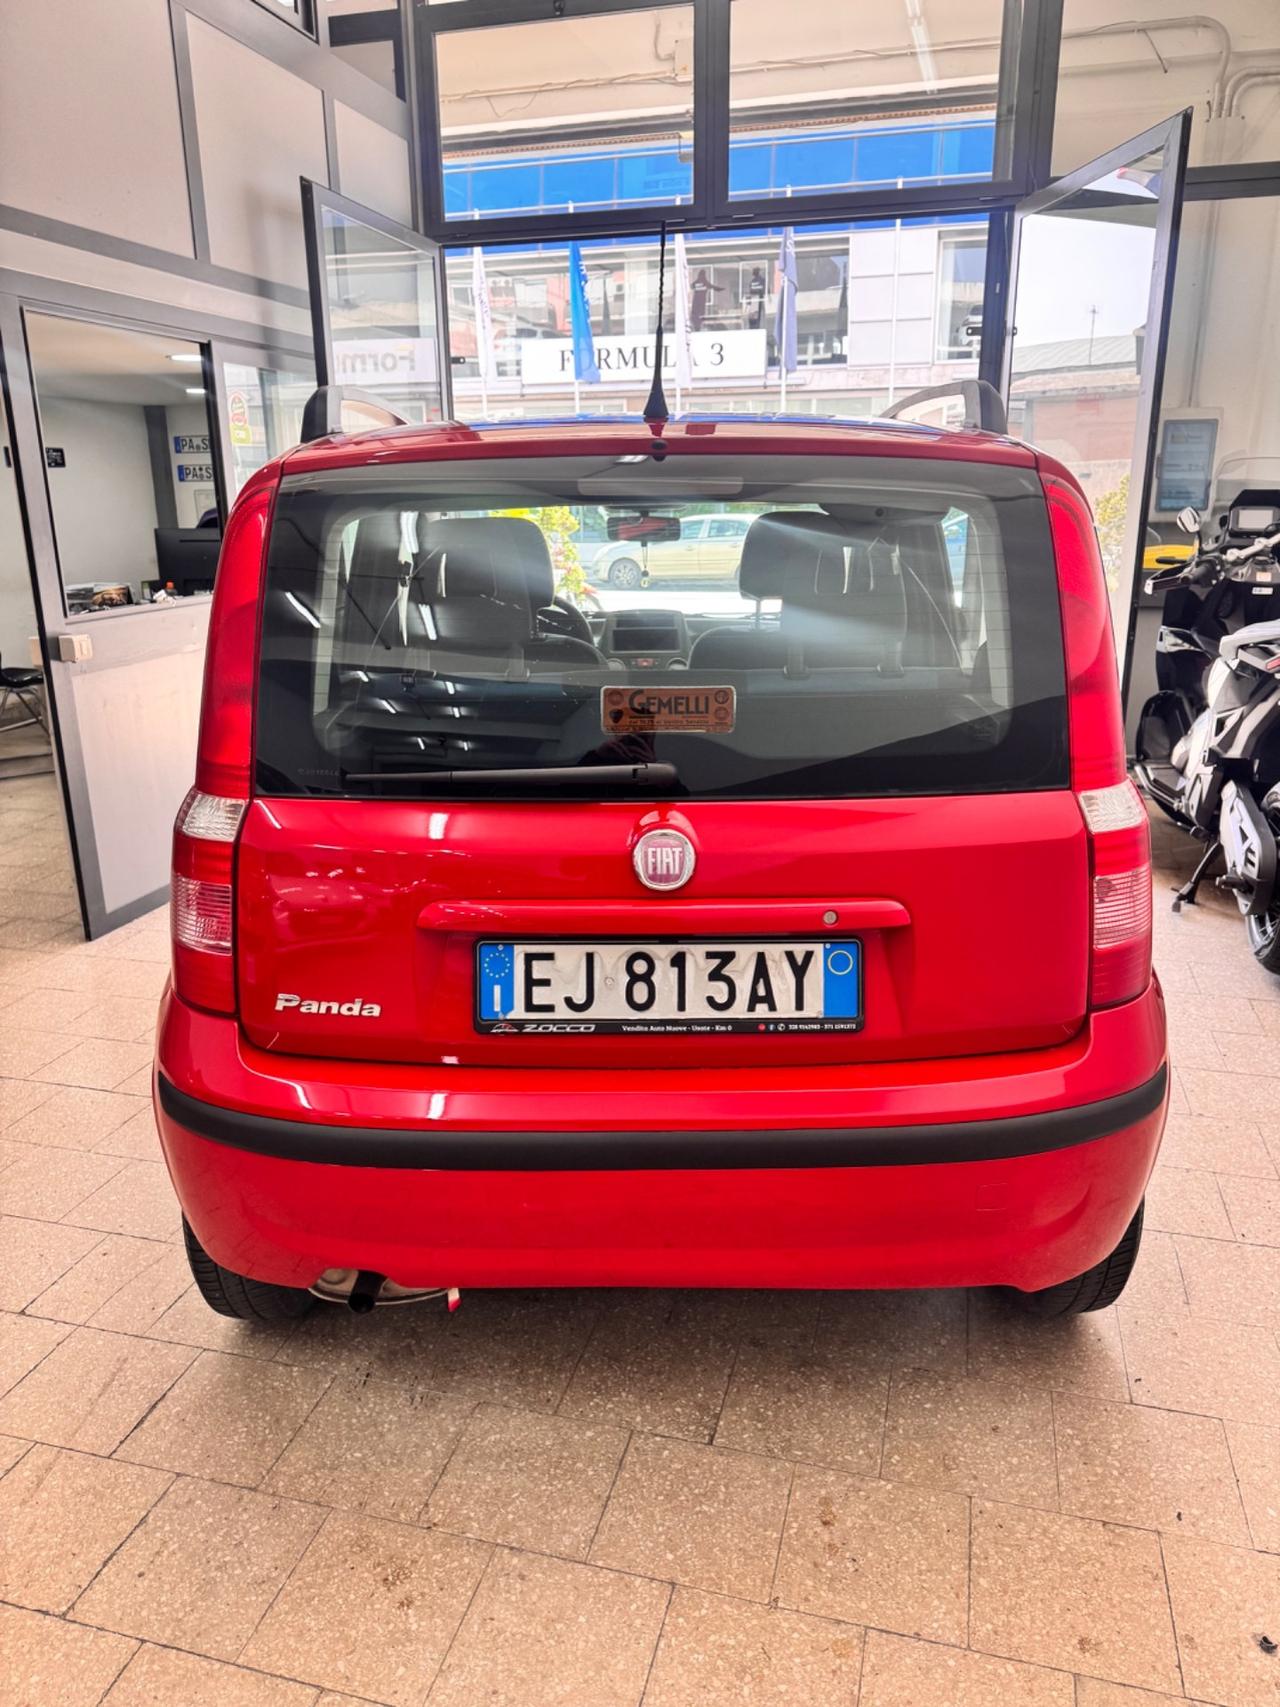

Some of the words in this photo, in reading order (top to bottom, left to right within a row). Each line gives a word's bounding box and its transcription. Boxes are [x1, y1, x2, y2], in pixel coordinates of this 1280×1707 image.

[559, 345, 699, 371] FRMUL
[710, 342, 724, 366] 3
[628, 689, 709, 715] GEMELLI
[648, 848, 682, 874] FIAT
[523, 952, 594, 1012] EJ
[625, 951, 814, 1012] 813AY
[275, 993, 381, 1017] Panda
[522, 1024, 595, 1032] ZOCCO
